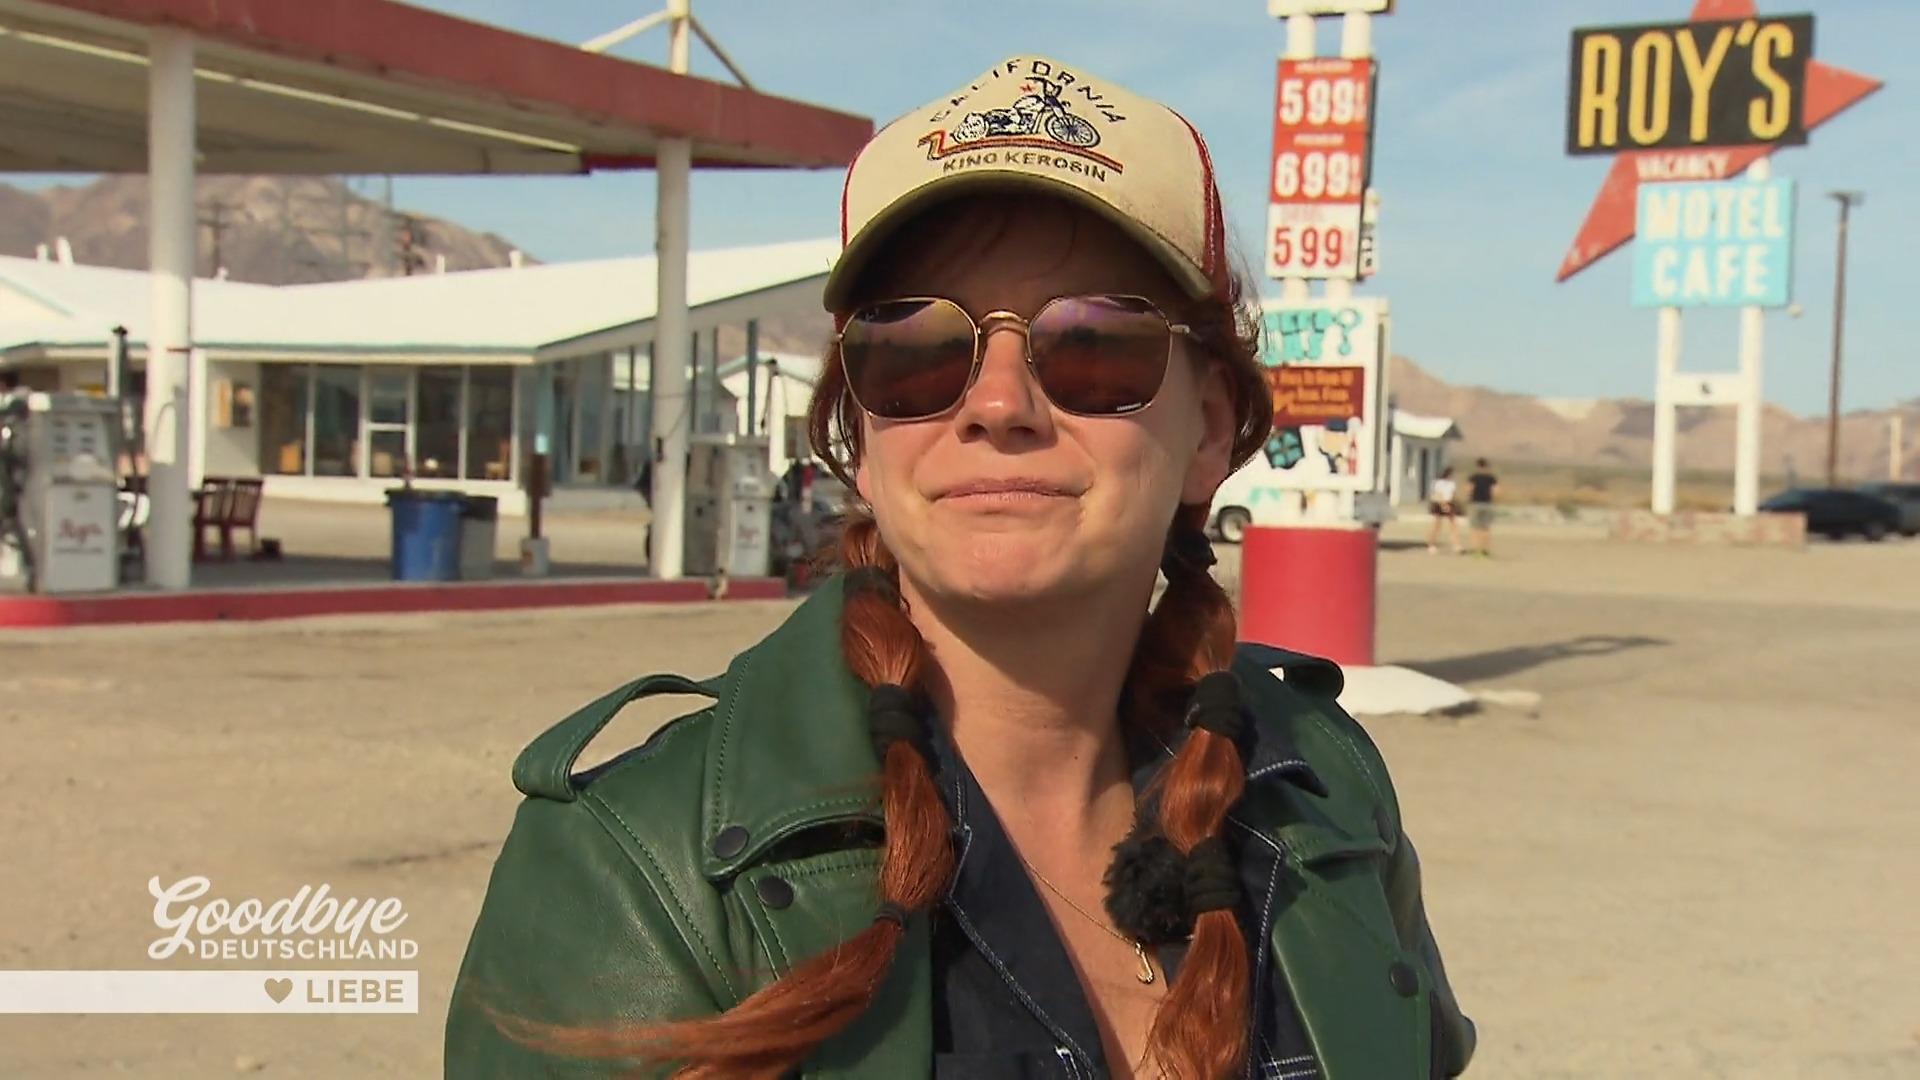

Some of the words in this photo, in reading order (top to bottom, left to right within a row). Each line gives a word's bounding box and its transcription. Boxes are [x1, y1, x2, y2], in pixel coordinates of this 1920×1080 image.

[930, 59, 1127, 123] CALIFORNIA
[1577, 19, 1794, 148] ROY'S
[1005, 151, 1107, 182] KEROSIN
[1645, 187, 1783, 241] MOTEL
[1652, 245, 1769, 300] CAFE
